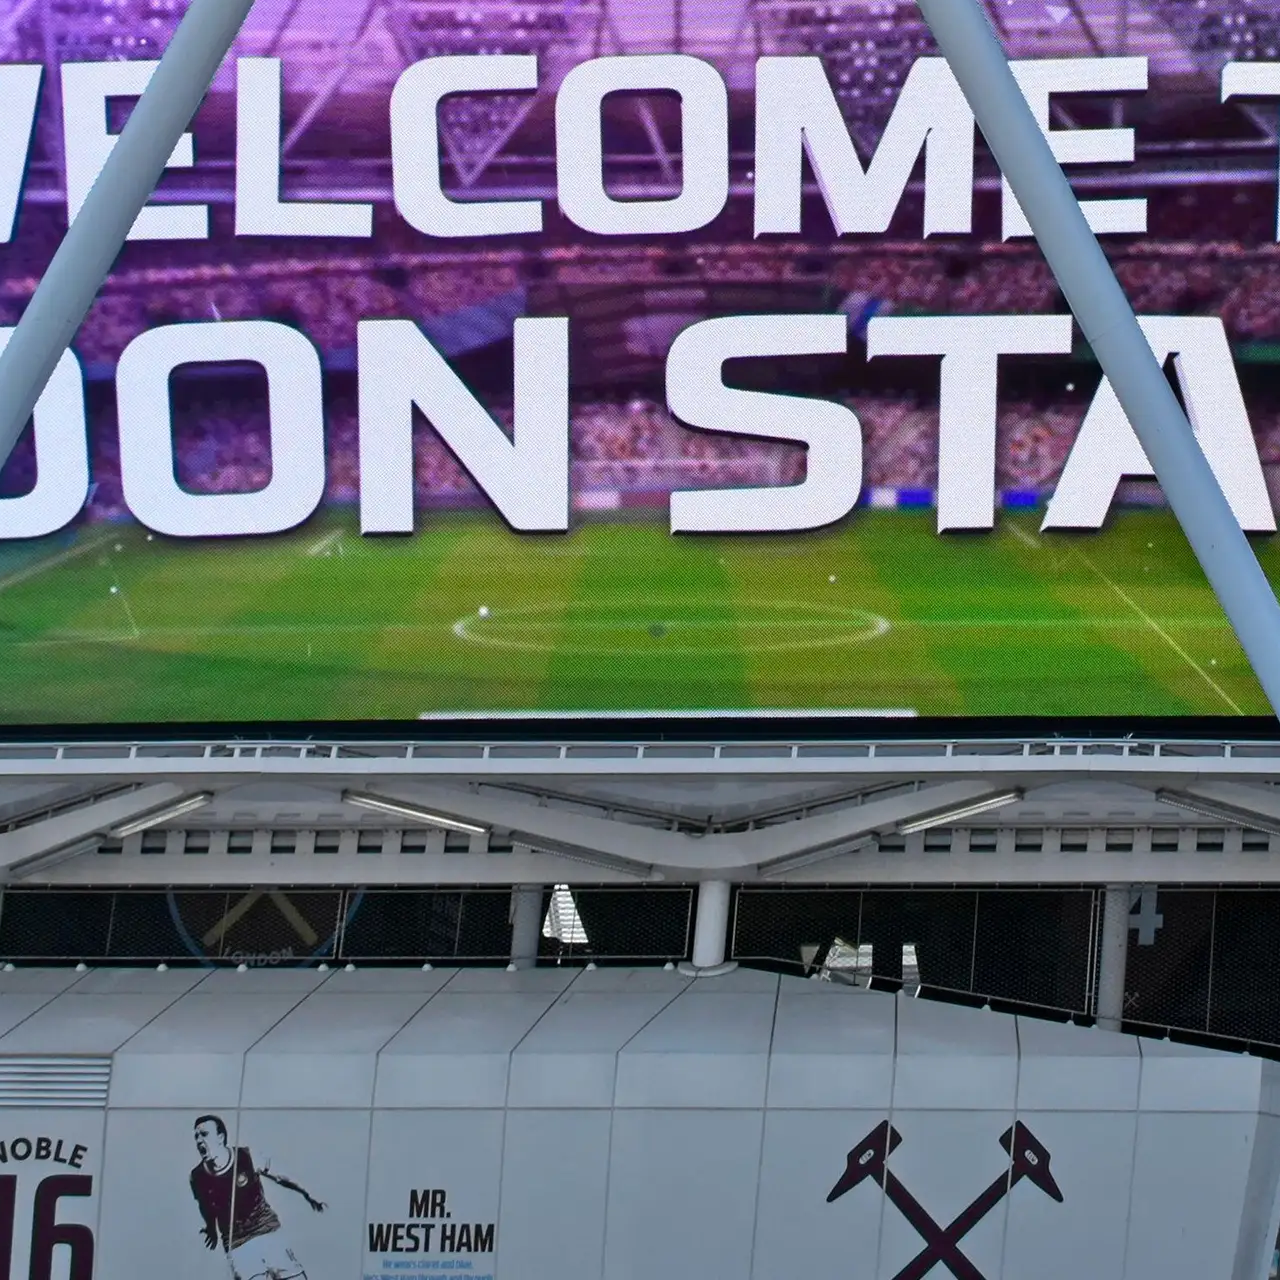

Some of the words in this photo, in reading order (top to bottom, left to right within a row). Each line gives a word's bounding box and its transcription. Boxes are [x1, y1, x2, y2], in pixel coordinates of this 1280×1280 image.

[408, 1189, 452, 1218] MR.
[368, 1223, 435, 1253] WEST
[440, 1223, 495, 1253] HAM
